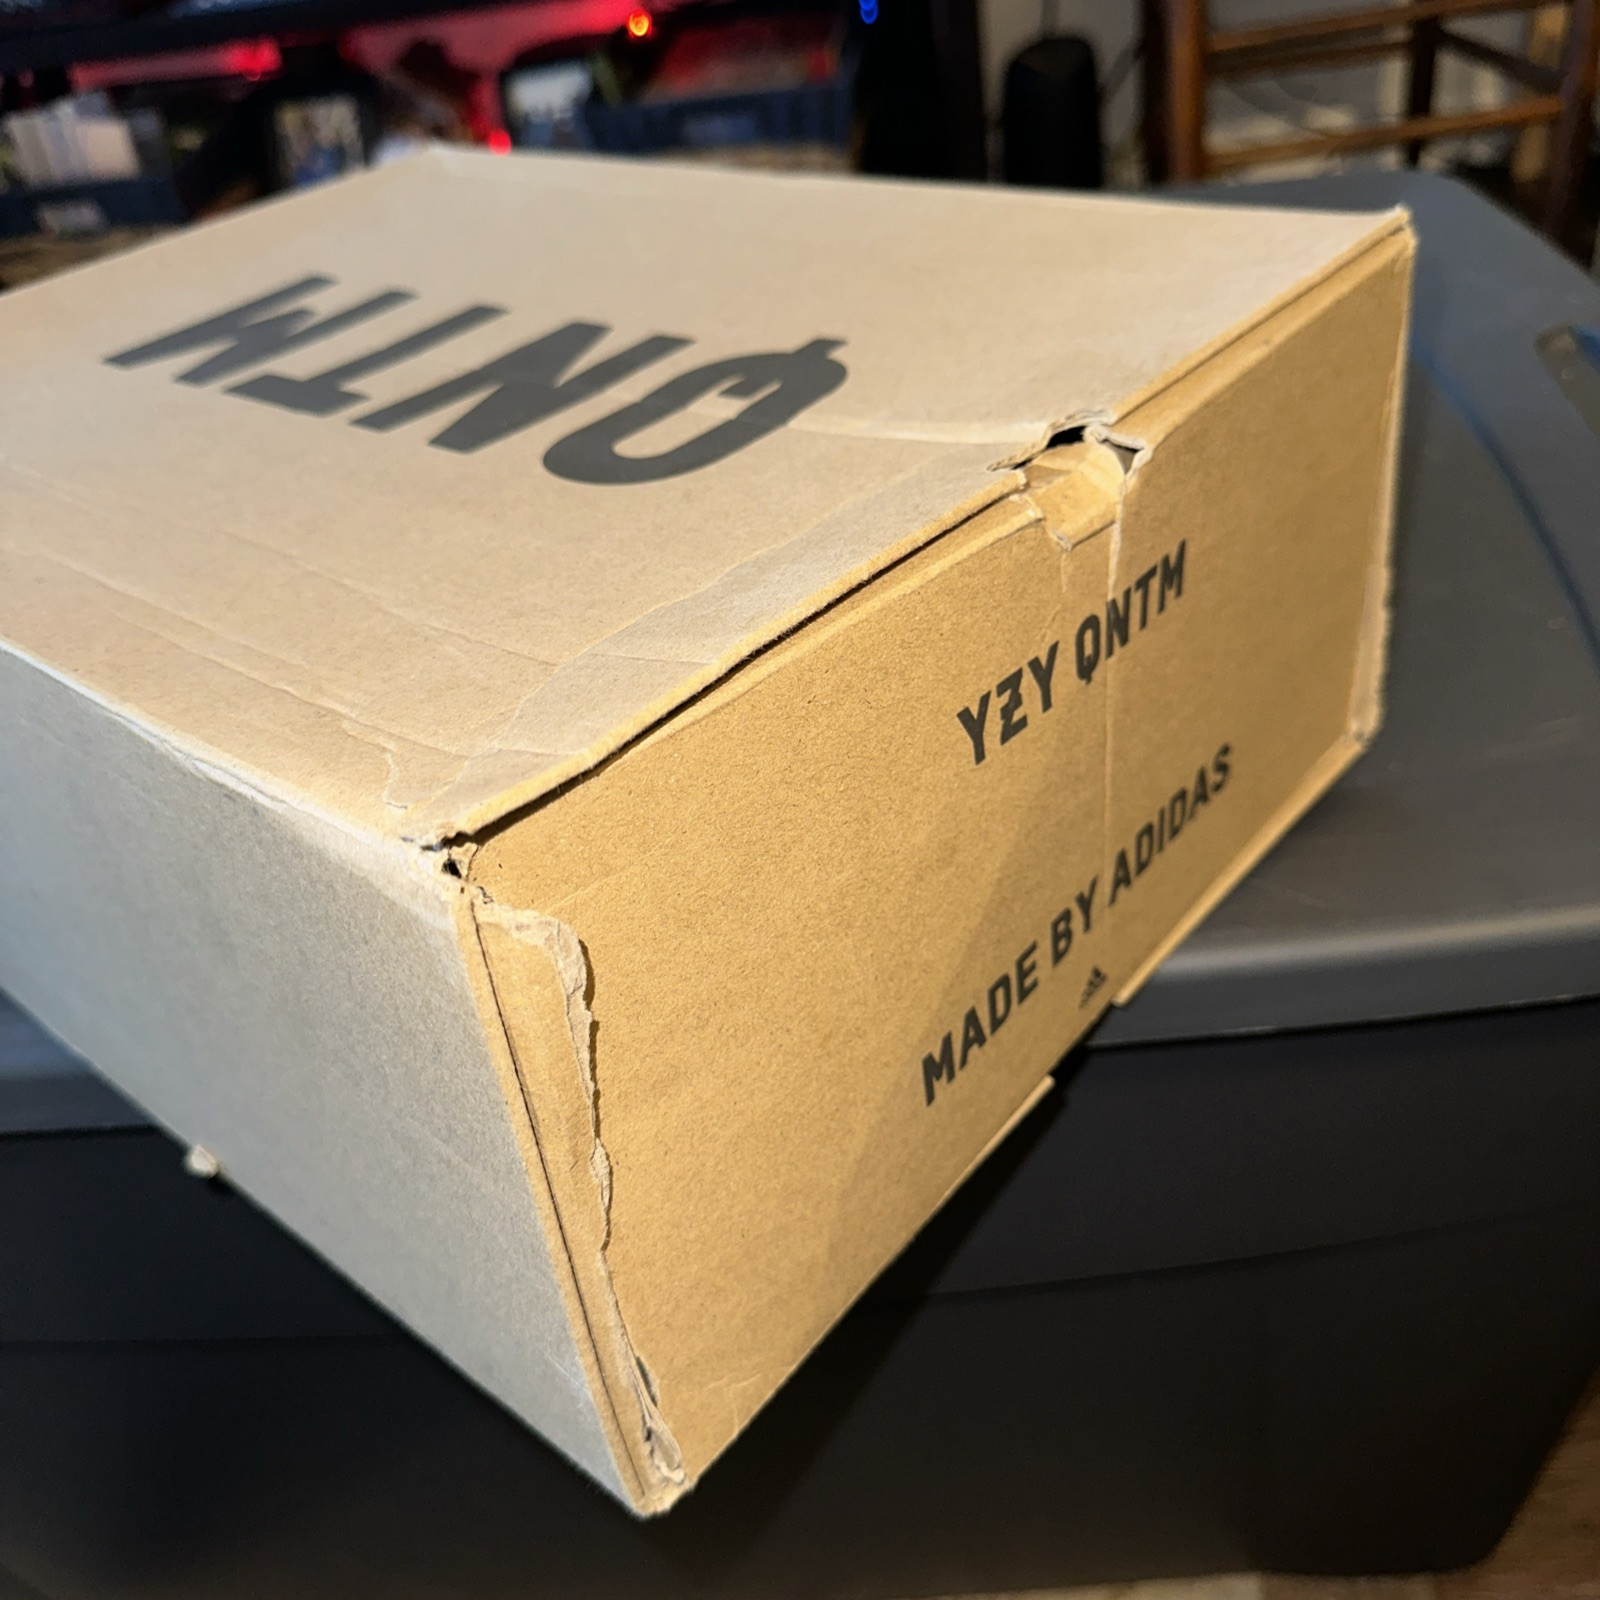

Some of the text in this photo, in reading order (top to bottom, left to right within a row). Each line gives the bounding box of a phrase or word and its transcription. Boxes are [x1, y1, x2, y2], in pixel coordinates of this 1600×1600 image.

[101, 273, 848, 486] QNTM
[956, 539, 1188, 766] YZY QNTM
[921, 743, 1233, 1107] MADE BY ADIDAS
